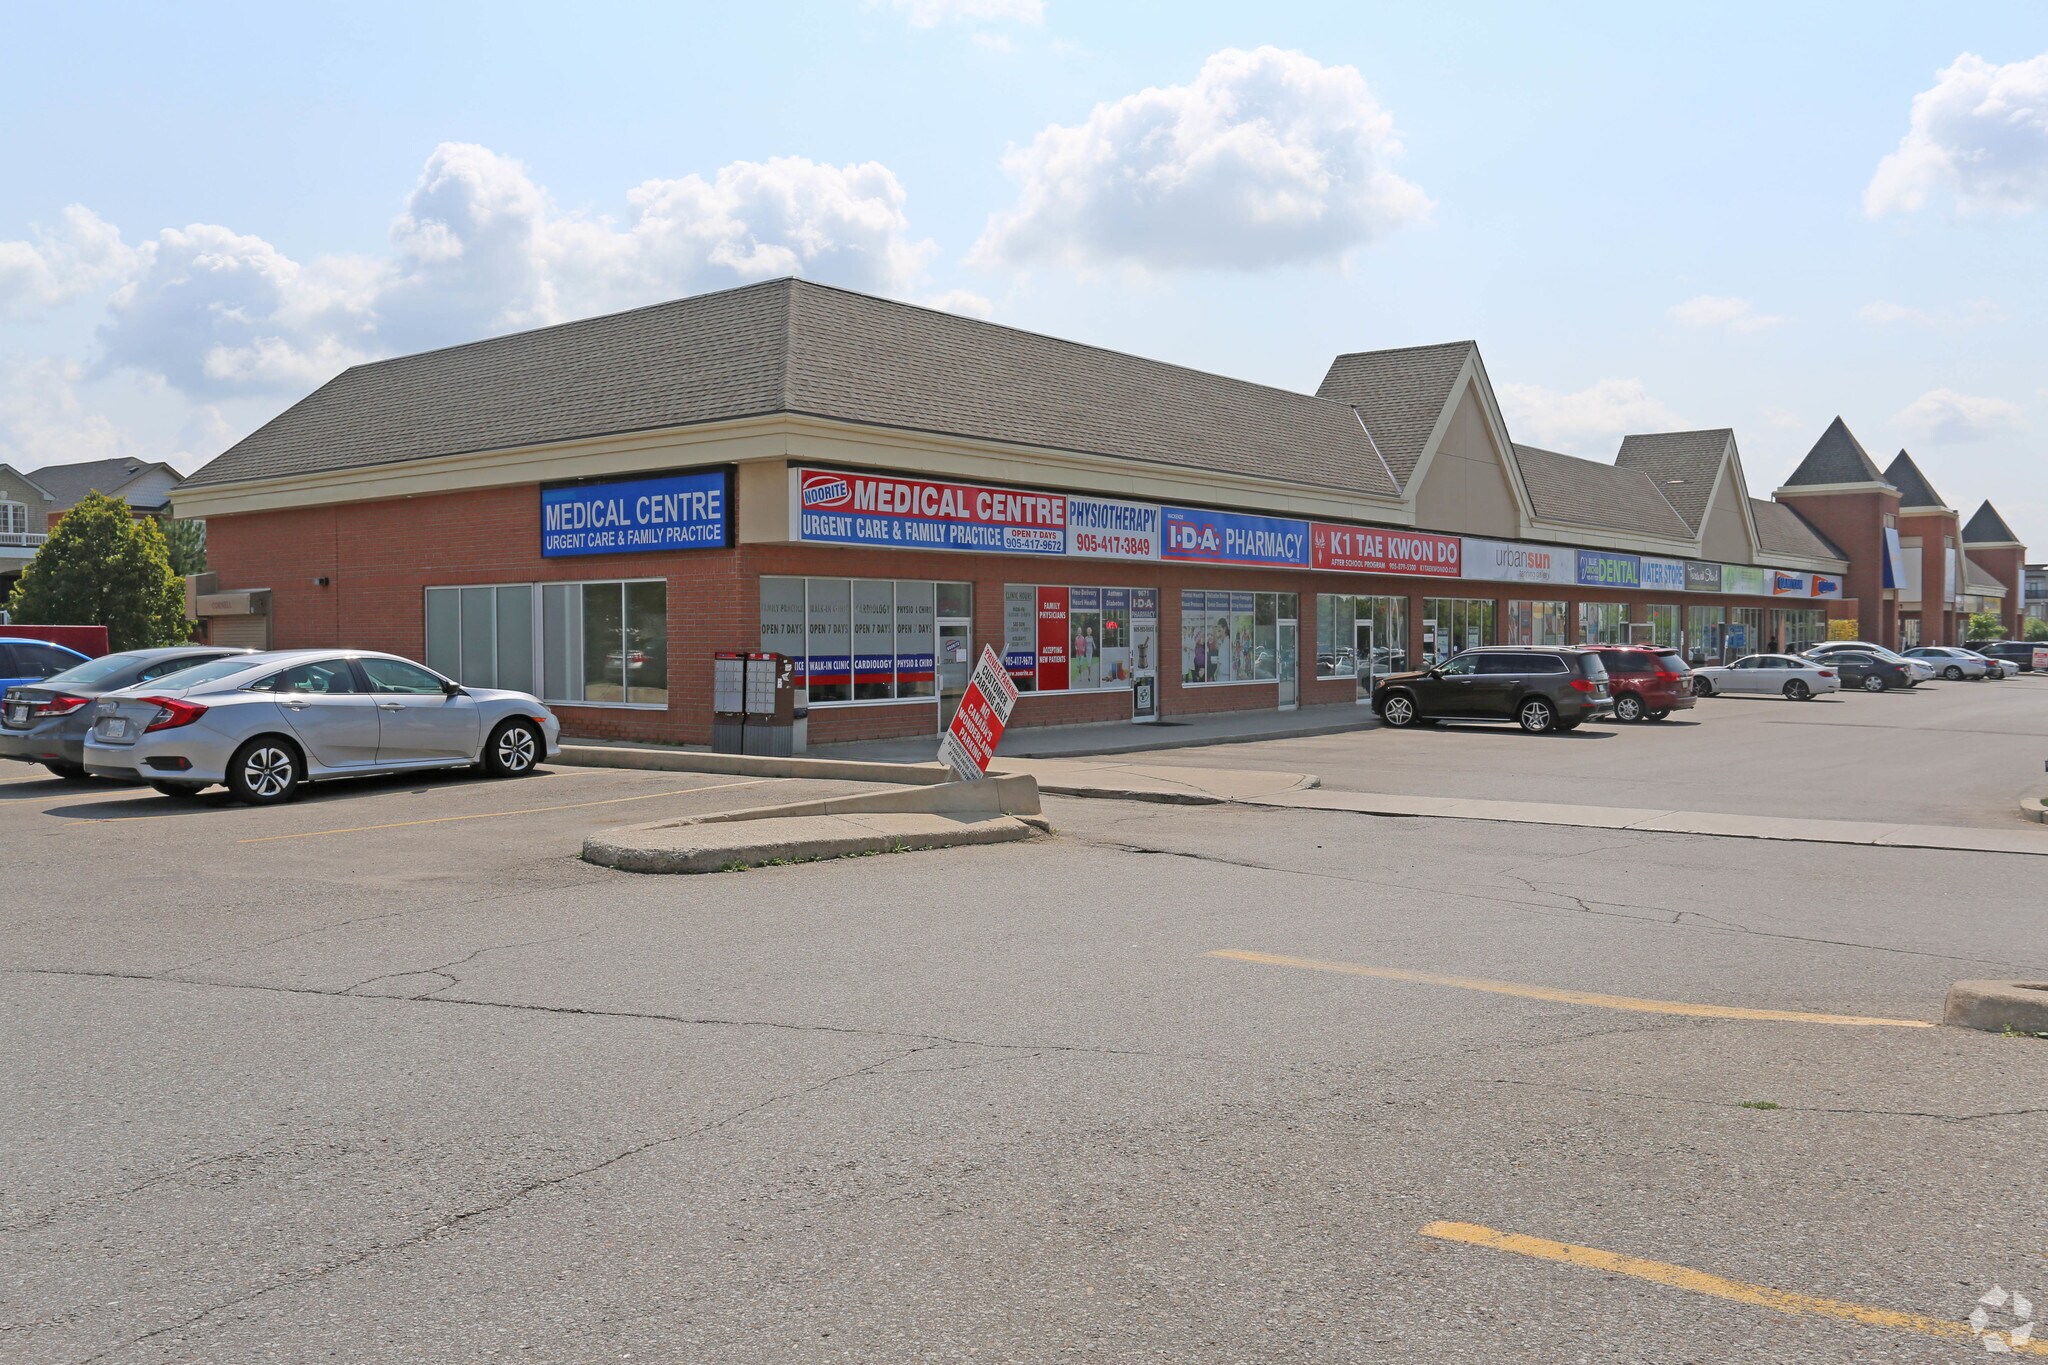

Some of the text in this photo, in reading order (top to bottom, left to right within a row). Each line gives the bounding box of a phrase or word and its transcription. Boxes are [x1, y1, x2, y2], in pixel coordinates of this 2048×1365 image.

[805, 482, 846, 504] NOORITE
[854, 480, 1064, 525] MEDICAL CENTRE
[546, 490, 721, 530] MEDICAL CENTRE
[1070, 501, 1156, 532] PHYSIOTHERAPY
[546, 524, 721, 549] URGENT CARE & FAMILY PRACTICE
[803, 514, 1001, 546] URGENT CARE & FAMILY PRACTICE
[1012, 529, 1056, 540] OPEN 7 DAYS
[1006, 538, 1061, 550] 905-417-9672
[1077, 533, 1150, 555] 905-417-3849
[1226, 528, 1302, 558] PHARMACY
[1331, 532, 1457, 563] K1 TAE KWON DO
[1599, 559, 1638, 584] DENTAL
[1641, 561, 1663, 583] WATER
[1664, 564, 1683, 585] STORE
[897, 606, 913, 614] PHYSIO
[919, 606, 932, 614] CHIRO
[762, 624, 803, 634] OPEN 7 DAYS
[810, 624, 849, 634] OPEN 7 DAYS
[855, 624, 891, 634] OPEN 7 DAYS
[898, 624, 912, 634] OPEN
[919, 624, 932, 634] DAYS
[795, 661, 805, 671] TICE
[809, 660, 850, 670] WALK-IN CLINIC
[855, 660, 892, 669] CARDIOLOGY
[897, 659, 914, 668] PHYSIO
[919, 659, 933, 667] CHIRO
[985, 648, 1018, 700] PRIVATE PARKING
[974, 671, 1008, 723] PARKING ONLY
[982, 665, 1008, 706] CUSTOMER
[967, 703, 993, 742] CANADA'S
[980, 702, 990, 719] NO
[959, 706, 993, 759] WONDERLAND
[959, 726, 982, 763] PARKING
